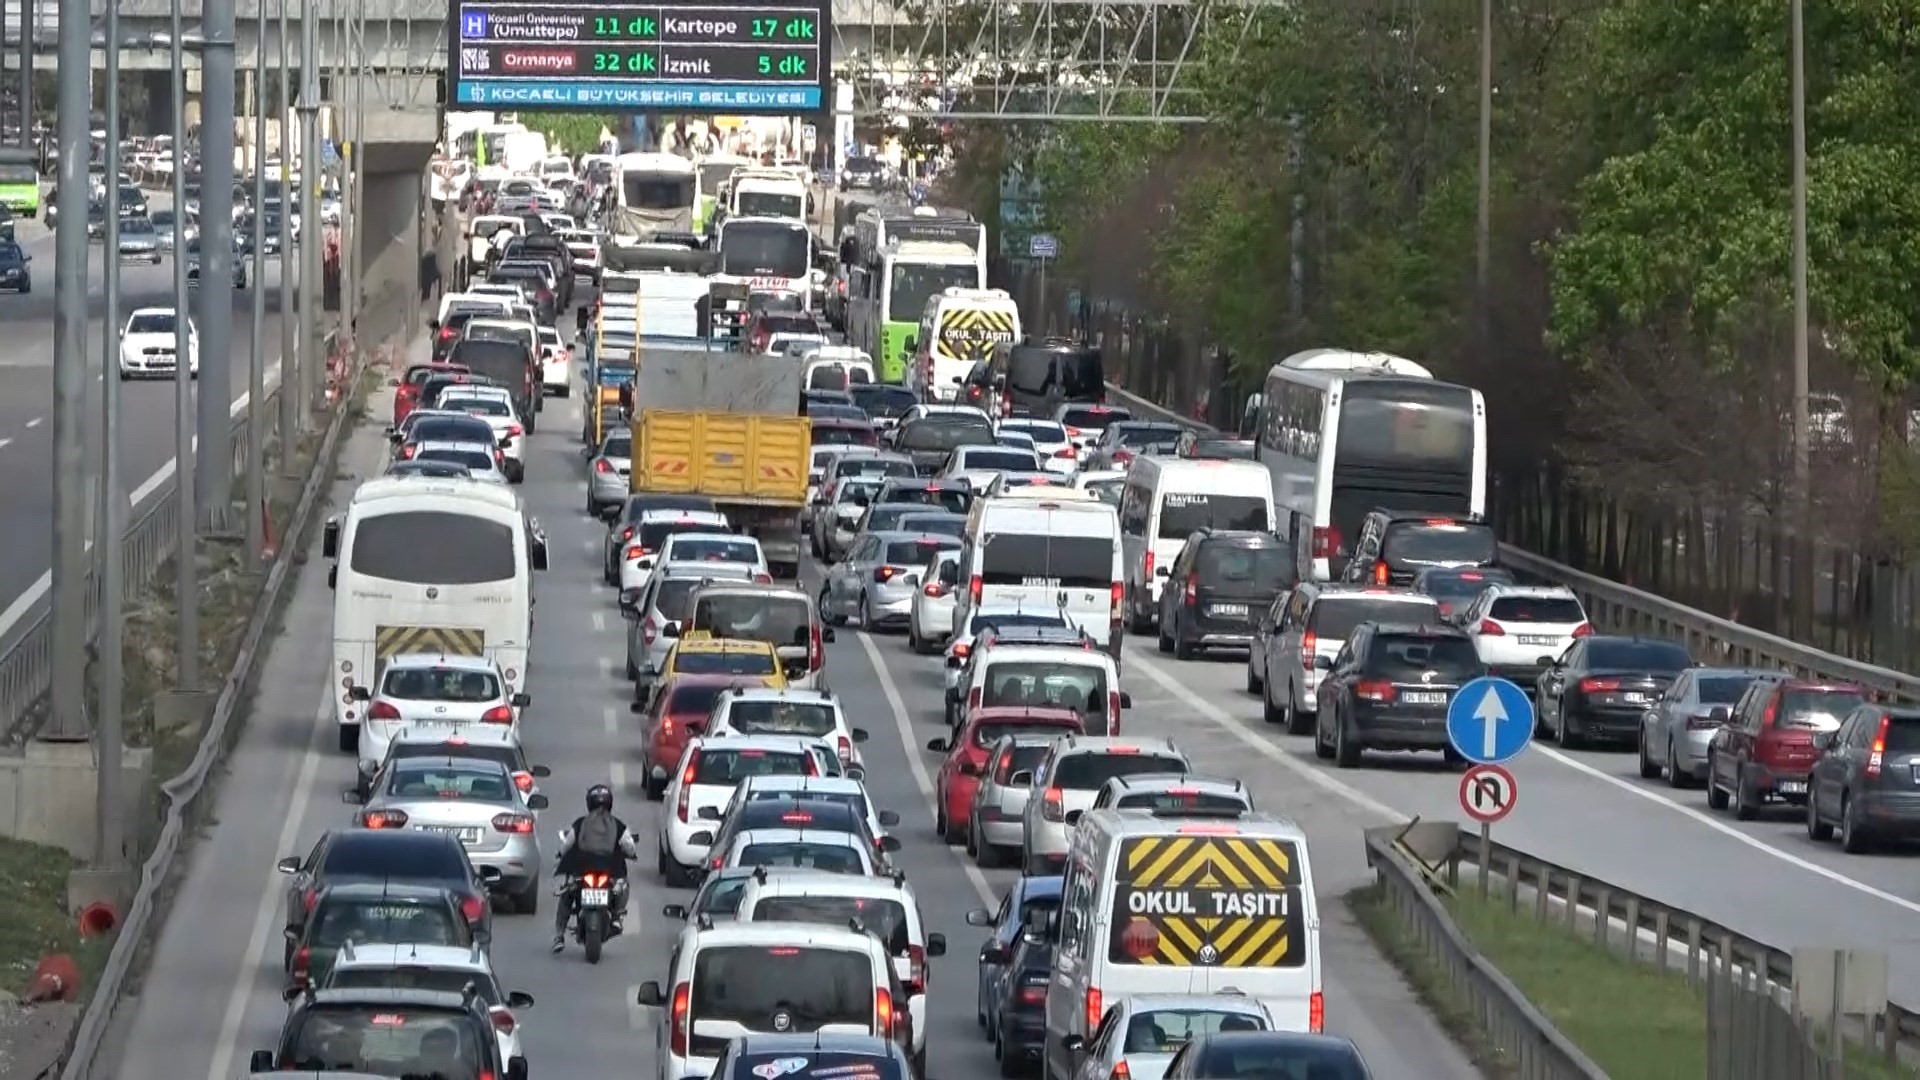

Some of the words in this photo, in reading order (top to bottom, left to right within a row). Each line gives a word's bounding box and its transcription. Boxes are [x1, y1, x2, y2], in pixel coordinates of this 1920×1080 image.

[488, 14, 525, 24] Kocaeli
[526, 12, 585, 25] Üniversitesi
[594, 18, 621, 35] 11
[628, 17, 656, 35] dk
[664, 18, 737, 37] Kartepe
[493, 25, 579, 39] (Umuttepe)
[751, 19, 778, 37] 17
[785, 19, 814, 38] dk
[504, 53, 573, 67] Ormanya
[593, 53, 620, 71] 32
[627, 52, 656, 71] dk
[664, 54, 711, 73] İzmit
[758, 56, 771, 73] 5
[778, 56, 807, 74] dk
[944, 329, 973, 340] OKUL
[1166, 493, 1208, 504] TRAVELLA
[1128, 890, 1196, 914] OKUL
[1211, 892, 1288, 919] TAŞITI
